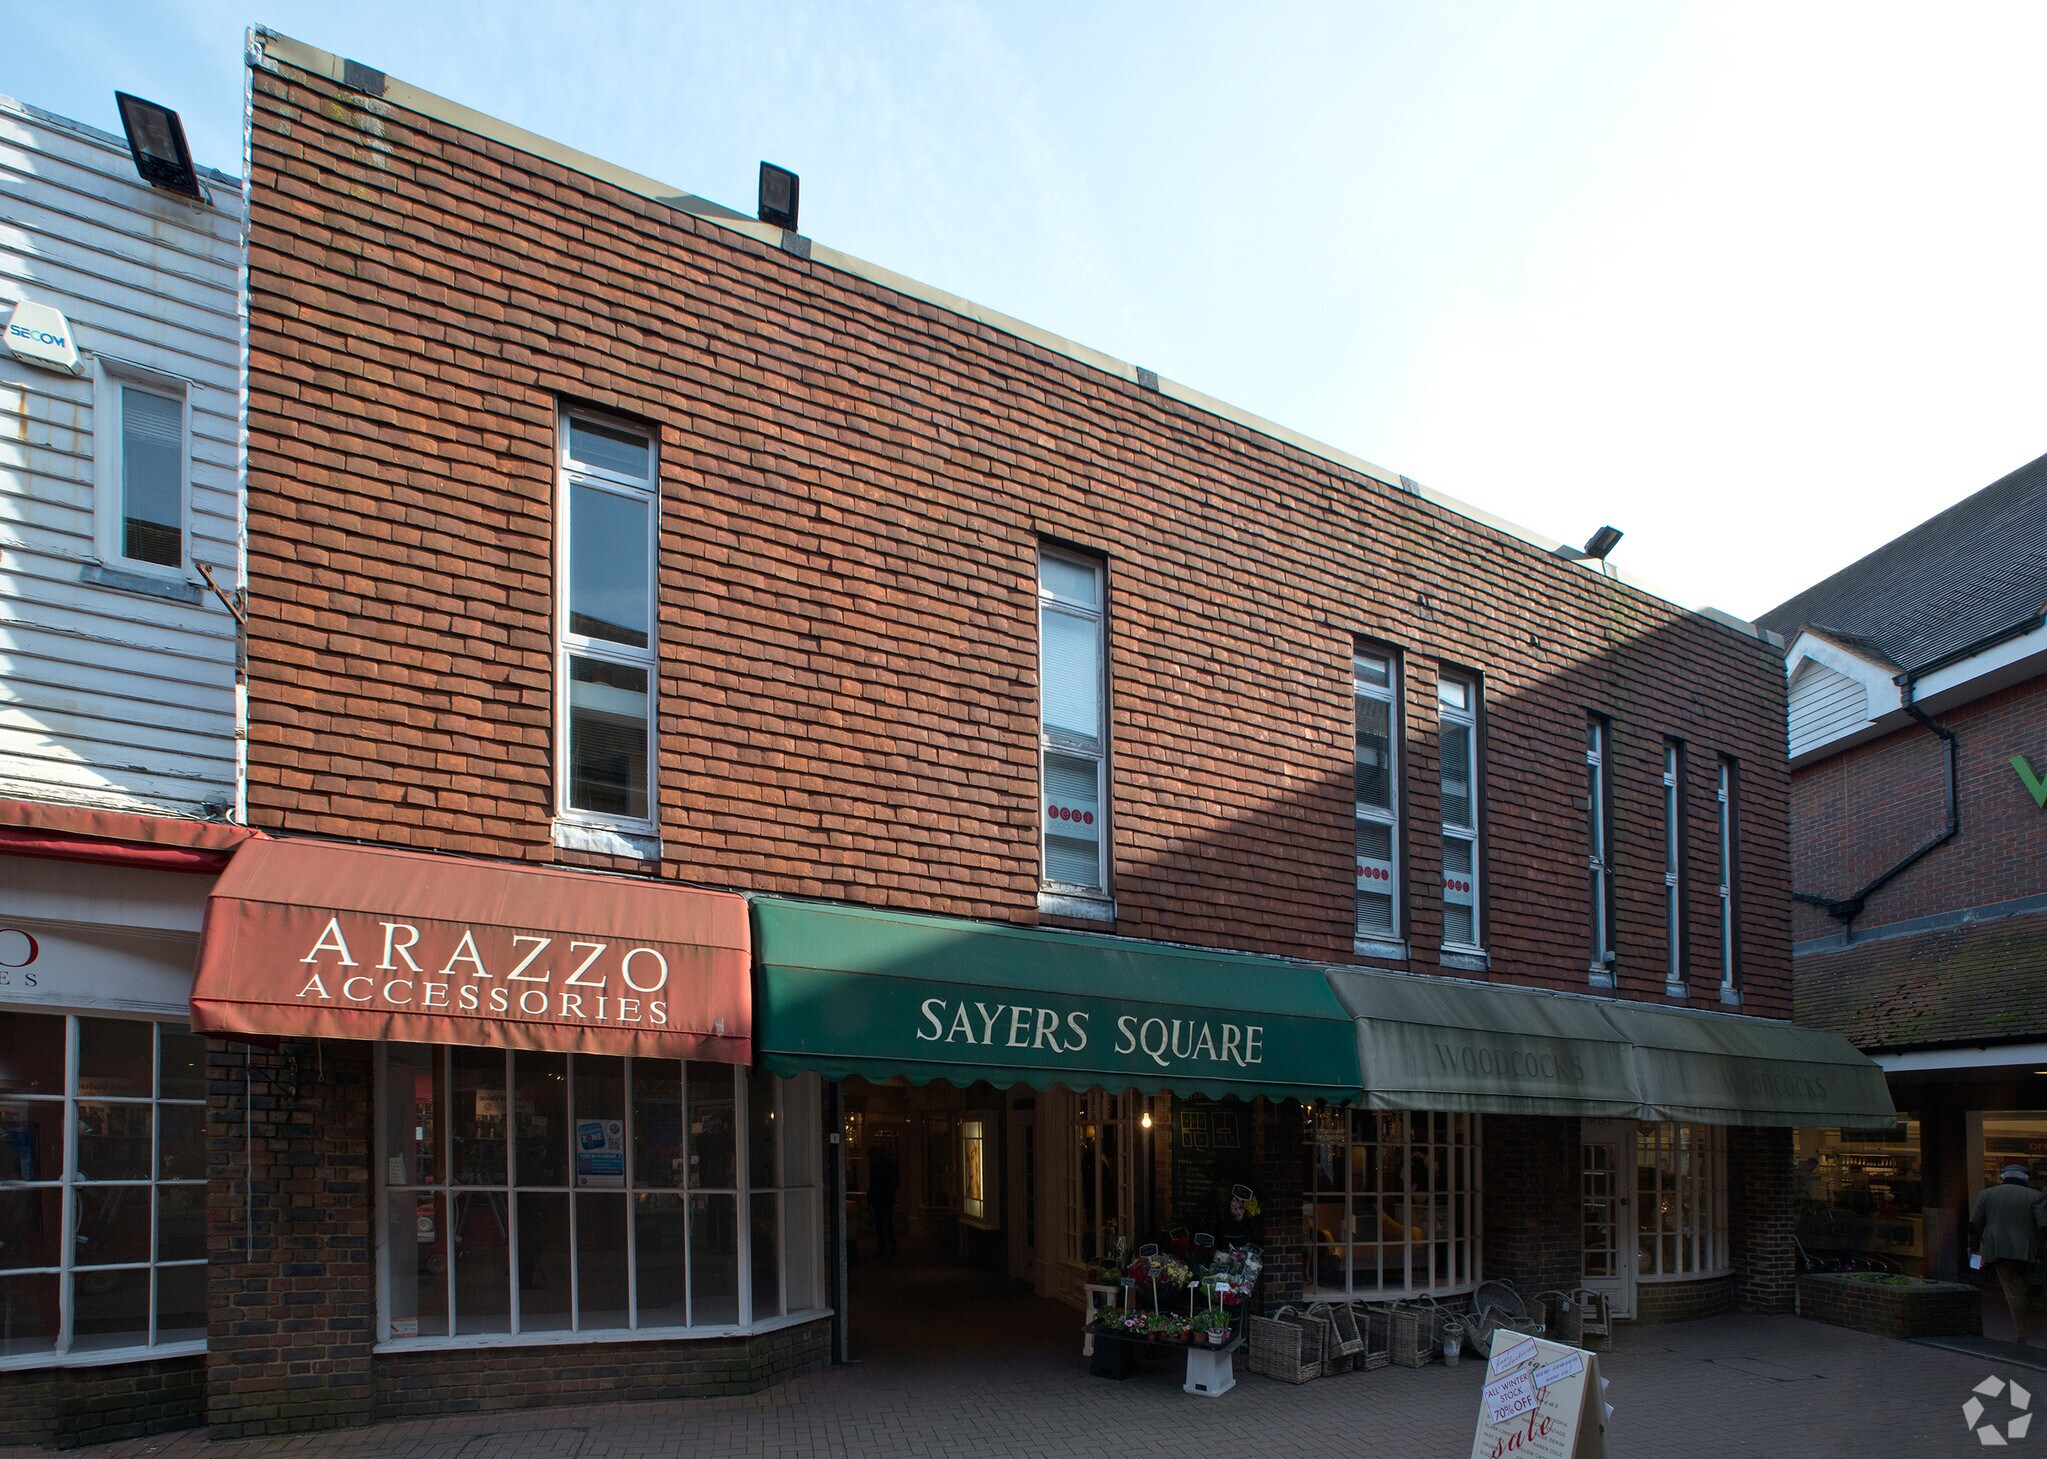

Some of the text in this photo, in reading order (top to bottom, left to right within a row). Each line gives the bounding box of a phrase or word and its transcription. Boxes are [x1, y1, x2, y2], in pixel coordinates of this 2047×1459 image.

[10, 324, 66, 349] SECOM
[299, 917, 671, 993] ARAZZO
[296, 973, 670, 1025] ACCESSORIES
[916, 998, 1264, 1068] SAYERS SQUARE
[1433, 1043, 1585, 1081] WOODCOCKS
[1500, 1387, 1524, 1403] STOCK
[1502, 1373, 1528, 1391] WINTER
[1492, 1390, 1555, 1459] sale
[1494, 1395, 1533, 1421] 70% OFF
